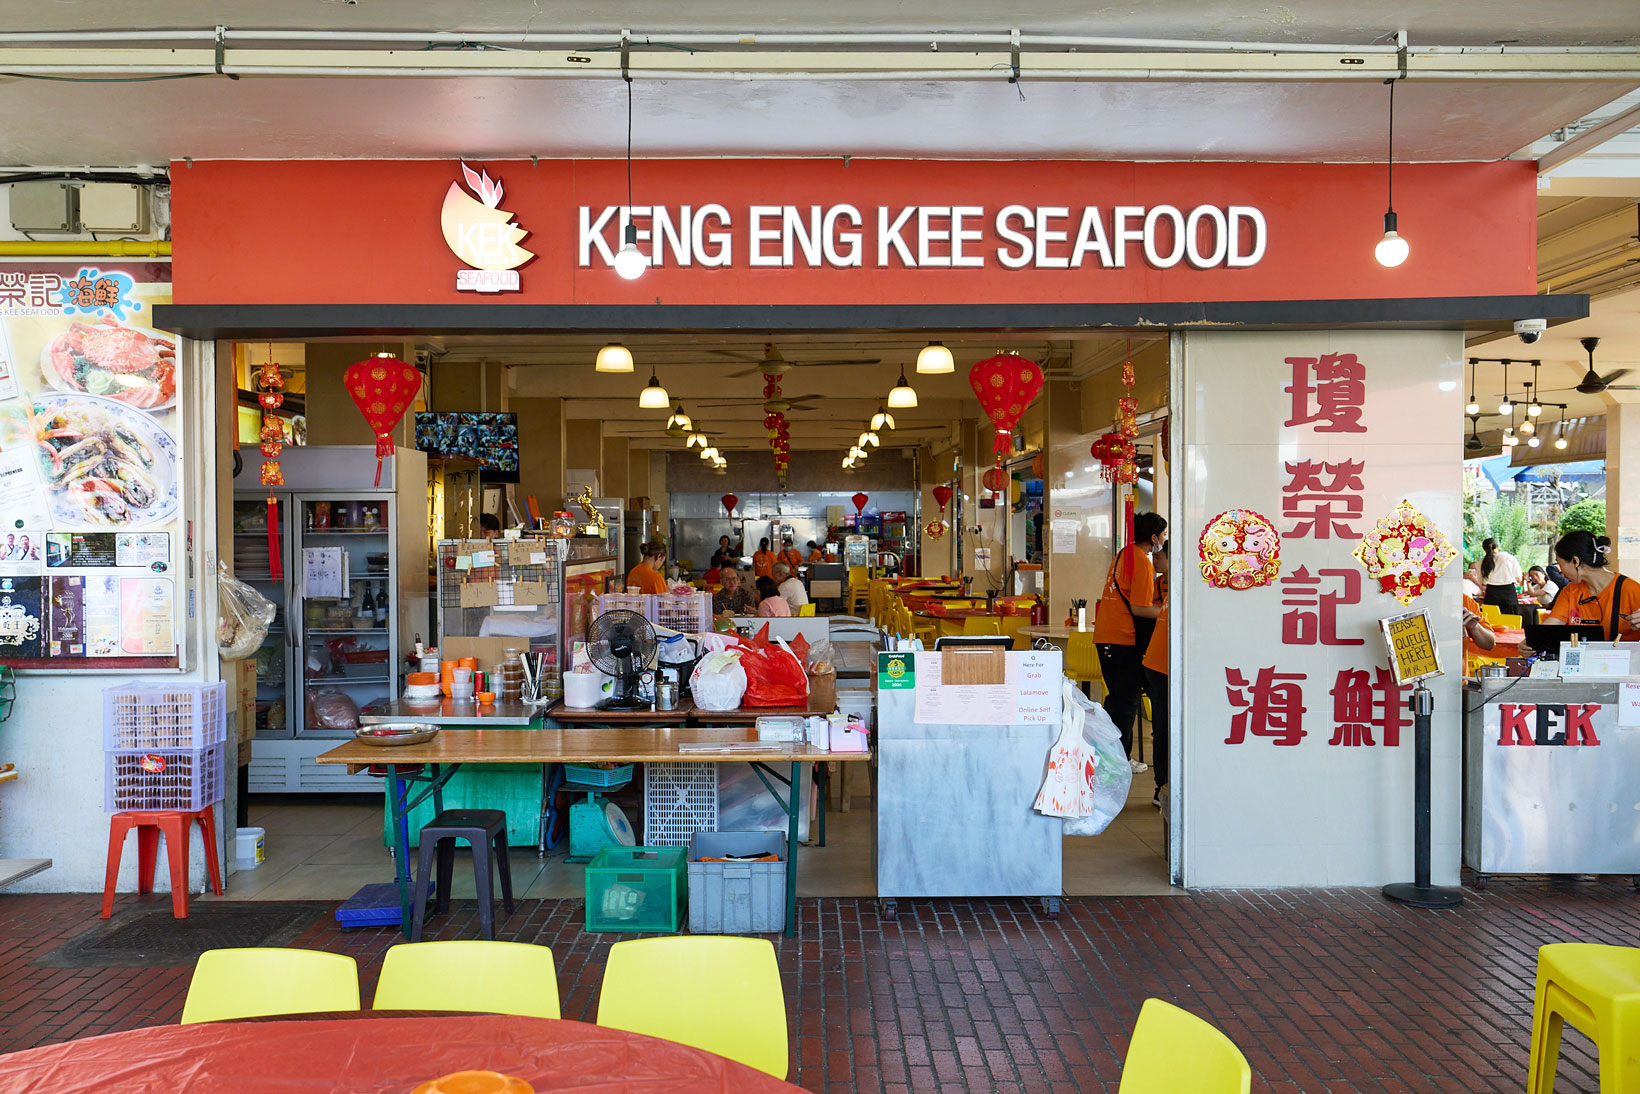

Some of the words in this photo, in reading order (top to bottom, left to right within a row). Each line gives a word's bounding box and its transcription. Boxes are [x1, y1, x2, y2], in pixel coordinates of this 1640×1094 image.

[457, 222, 519, 266] KEK
[578, 204, 732, 267] KENG
[749, 204, 862, 267] ENG
[877, 205, 984, 267] KEE
[994, 204, 1267, 269] SEAFOOD
[458, 271, 519, 286] SEAFOOD
[68, 276, 120, 308] 海鮮
[4, 308, 19, 316] KEE
[20, 308, 60, 316] SEAFOOD
[1388, 616, 1417, 635] PLEASE
[1395, 630, 1428, 651] QUEUE
[1400, 643, 1432, 666] HERE
[1224, 664, 1414, 747] 海鮮
[1037, 715, 1047, 723] Up
[1498, 704, 1601, 746] KEK
